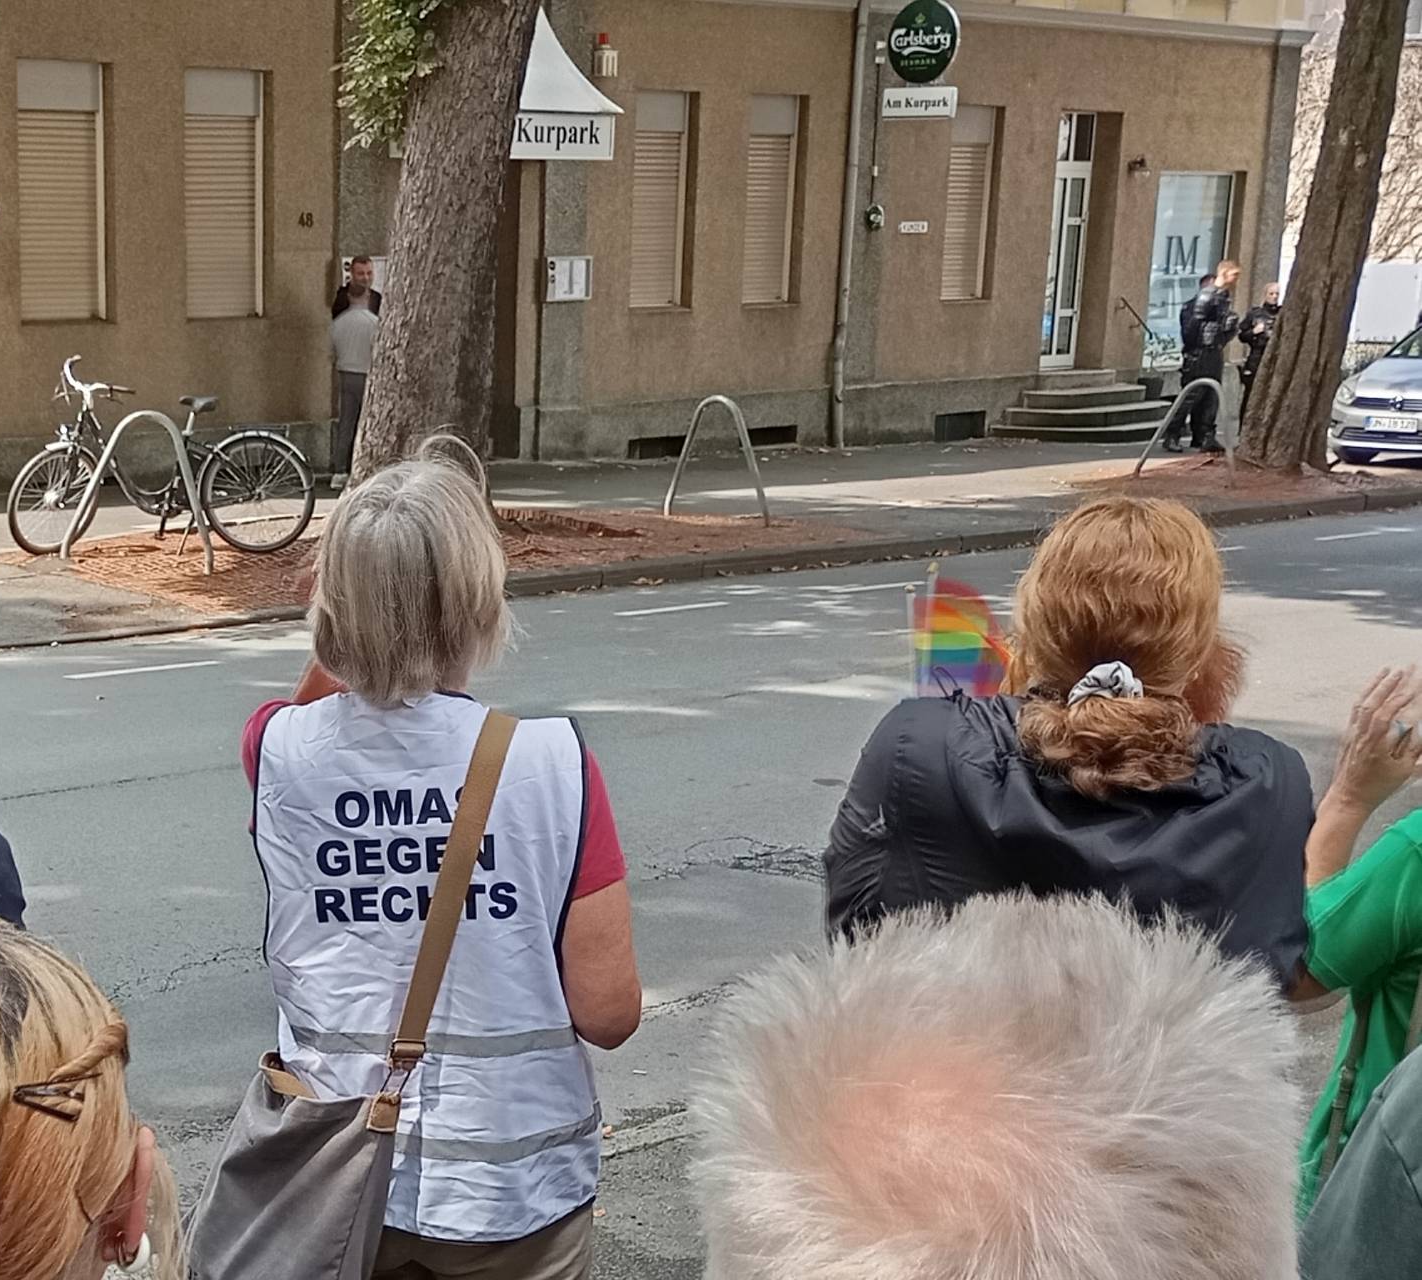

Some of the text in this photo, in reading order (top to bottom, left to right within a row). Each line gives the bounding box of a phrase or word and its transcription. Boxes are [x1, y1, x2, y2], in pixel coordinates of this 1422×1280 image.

[890, 26, 951, 55] Carlsberg
[884, 96, 949, 111] Am Kurpark
[516, 117, 600, 151] Kurpark
[298, 211, 314, 228] 48
[334, 785, 465, 828] OMA
